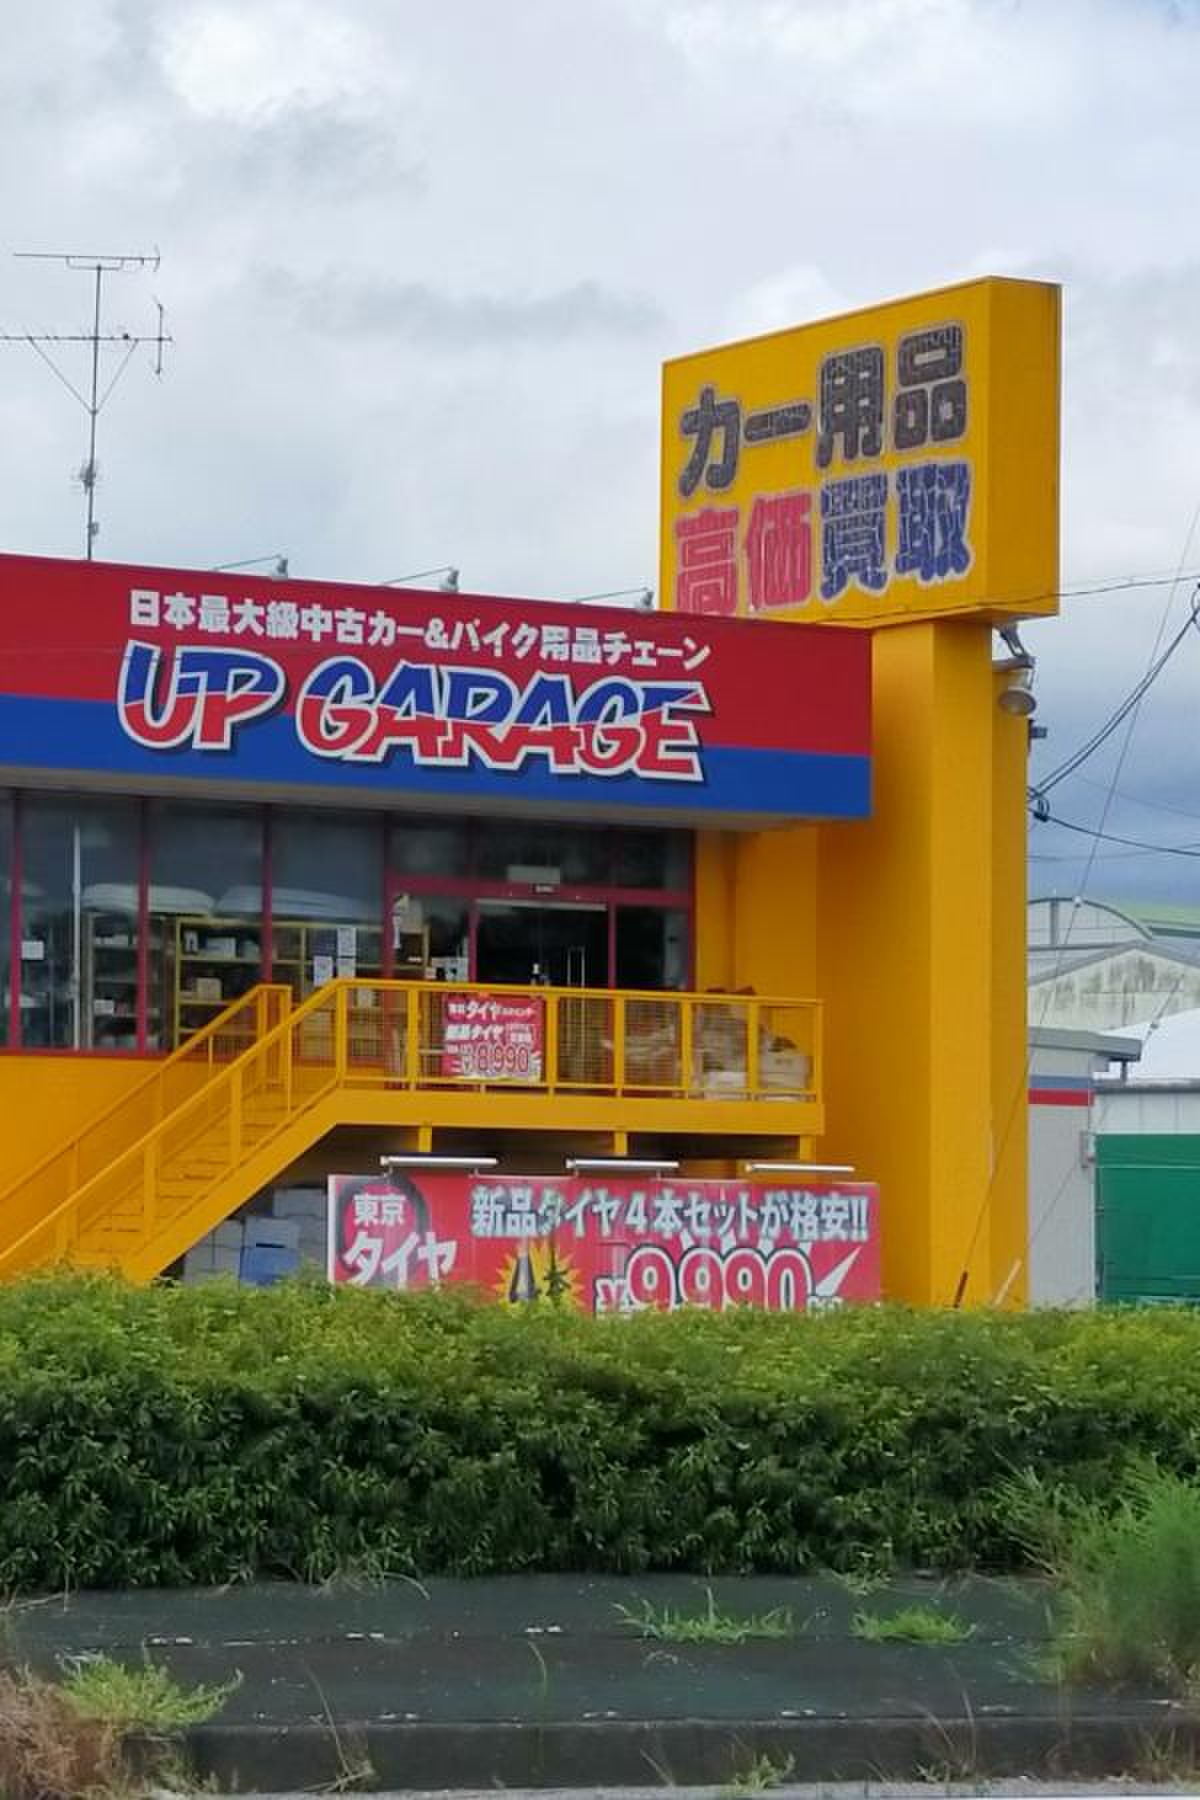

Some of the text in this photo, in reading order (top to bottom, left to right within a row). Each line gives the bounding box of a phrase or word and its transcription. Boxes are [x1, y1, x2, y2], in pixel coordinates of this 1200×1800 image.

[678, 320, 968, 498] カー用品
[674, 459, 974, 617] 高価買取
[129, 590, 712, 672] 日本最大級中古カー&バイク用品チェーン
[117, 639, 712, 783] UP GARAGE
[343, 1231, 459, 1290] タイヤ
[353, 1193, 406, 1228] 東京
